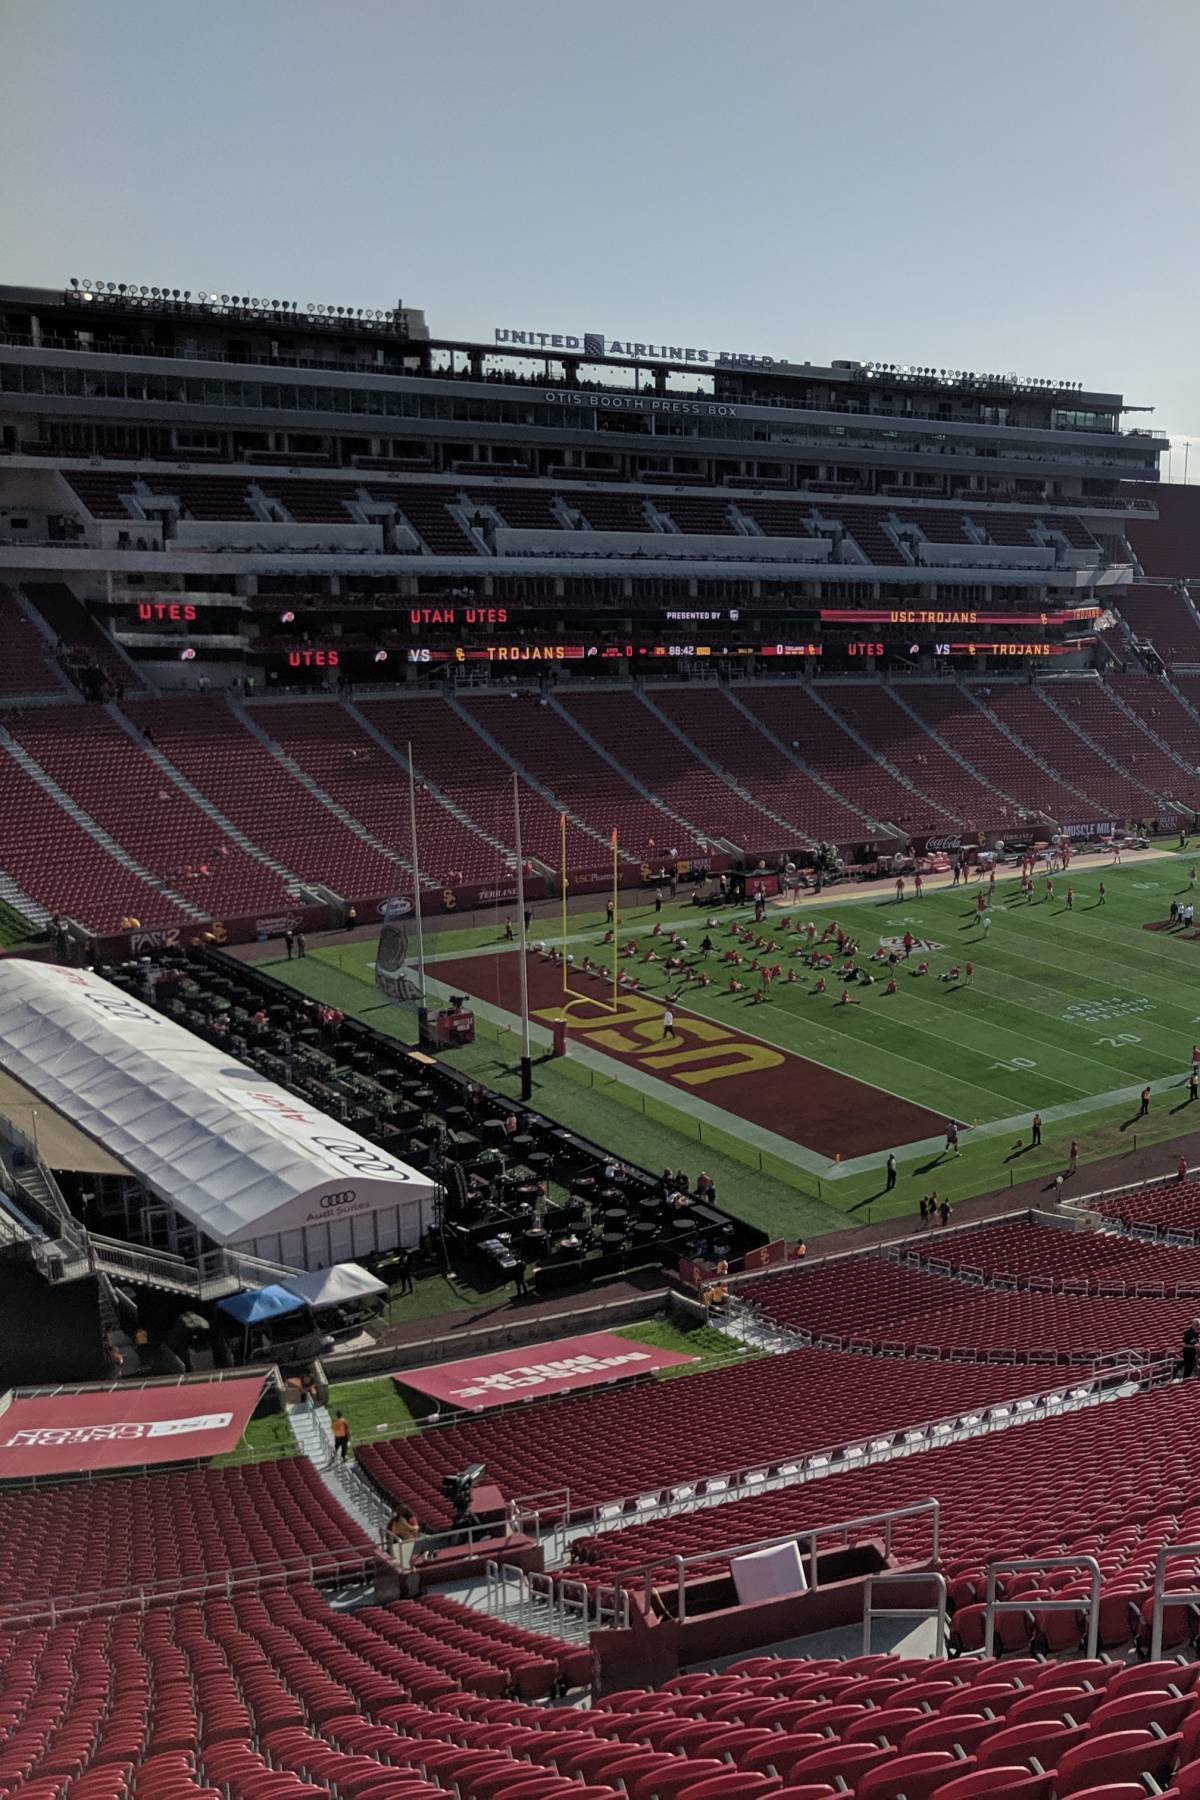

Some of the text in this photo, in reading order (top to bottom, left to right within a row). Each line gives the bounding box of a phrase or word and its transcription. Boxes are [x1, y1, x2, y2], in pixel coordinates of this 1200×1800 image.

[495, 328, 775, 369] UNITED AIRLINES FIELD
[545, 391, 737, 417] OTIS BOOTH PRESS BOX
[139, 604, 196, 620] UTES
[411, 609, 507, 623] UTAH UTES
[667, 612, 709, 620] PRESENTED
[712, 612, 721, 620] BY
[891, 612, 915, 623] USC
[920, 612, 977, 623] TROJANS
[410, 649, 431, 662] VS
[487, 647, 565, 660] TROJANS
[848, 643, 884, 655] UTES
[936, 644, 950, 655] VS
[992, 645, 1050, 655] TROJANS
[289, 651, 338, 666] UTES
[1063, 822, 1118, 836] MUSCLE MILK
[443, 889, 456, 909] SC
[530, 995, 786, 1086] USC
[1101, 1033, 1142, 1048] 20
[1000, 1057, 1037, 1072] 10
[247, 1091, 315, 1125] Audi
[306, 1201, 371, 1222] Audi Suites
[448, 1351, 652, 1399] MUSCLE
[471, 1353, 600, 1386] MILK
[0, 1415, 225, 1448] USC CREDIT
[14, 1424, 144, 1441] UNION
